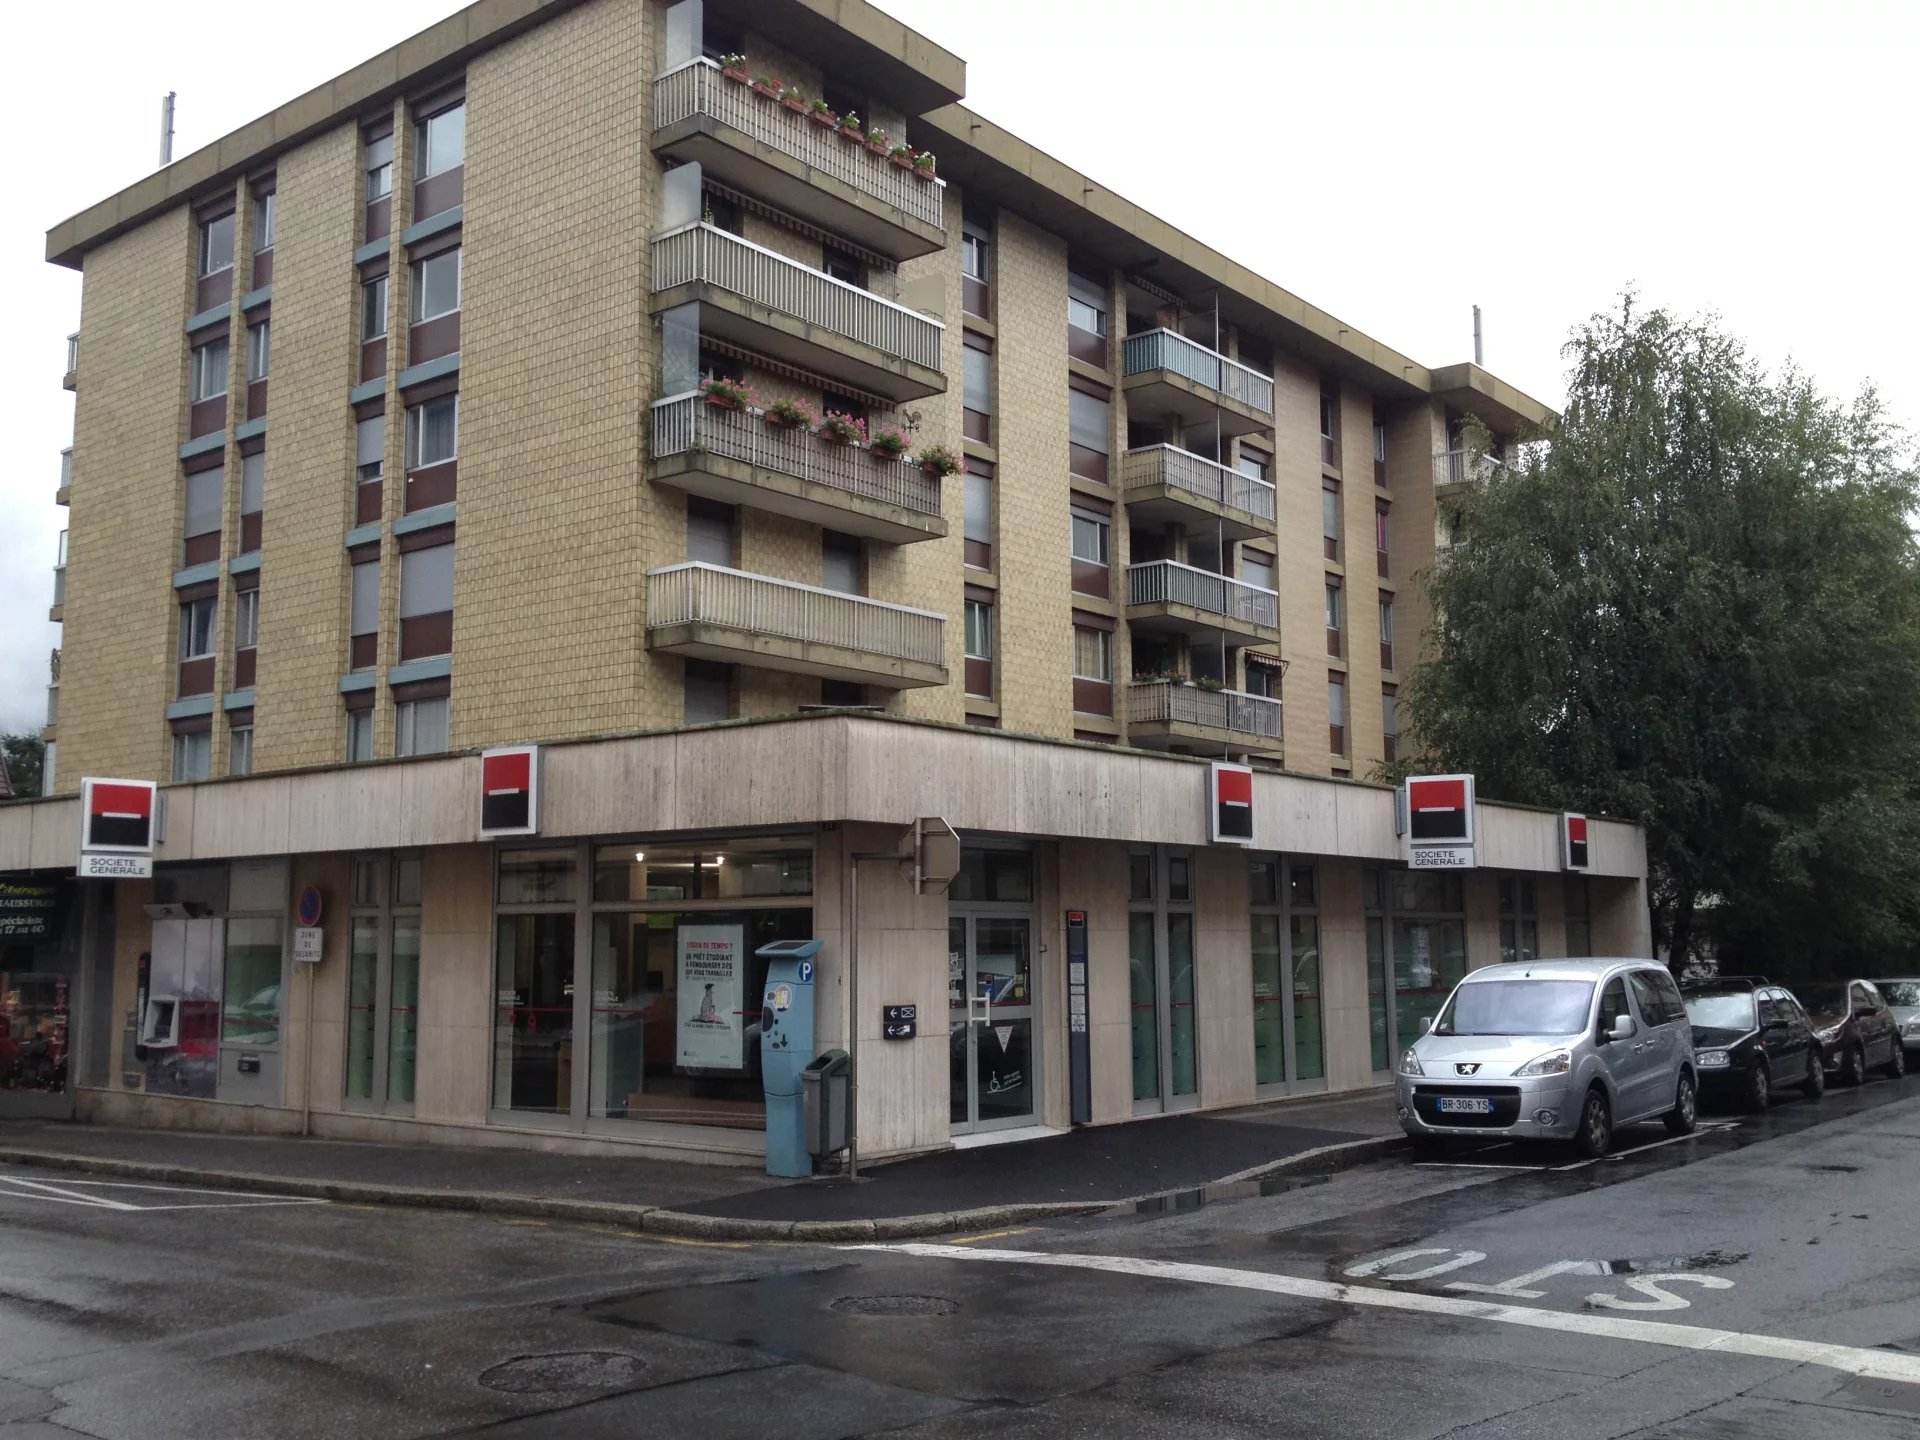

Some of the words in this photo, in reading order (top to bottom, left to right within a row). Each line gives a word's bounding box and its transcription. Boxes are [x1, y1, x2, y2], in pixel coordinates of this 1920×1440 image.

[1414, 850, 1456, 858] SOCIETE
[90, 858, 136, 867] SOCIETE
[1414, 857, 1466, 866] GENERALE
[90, 866, 145, 875] GENERALE
